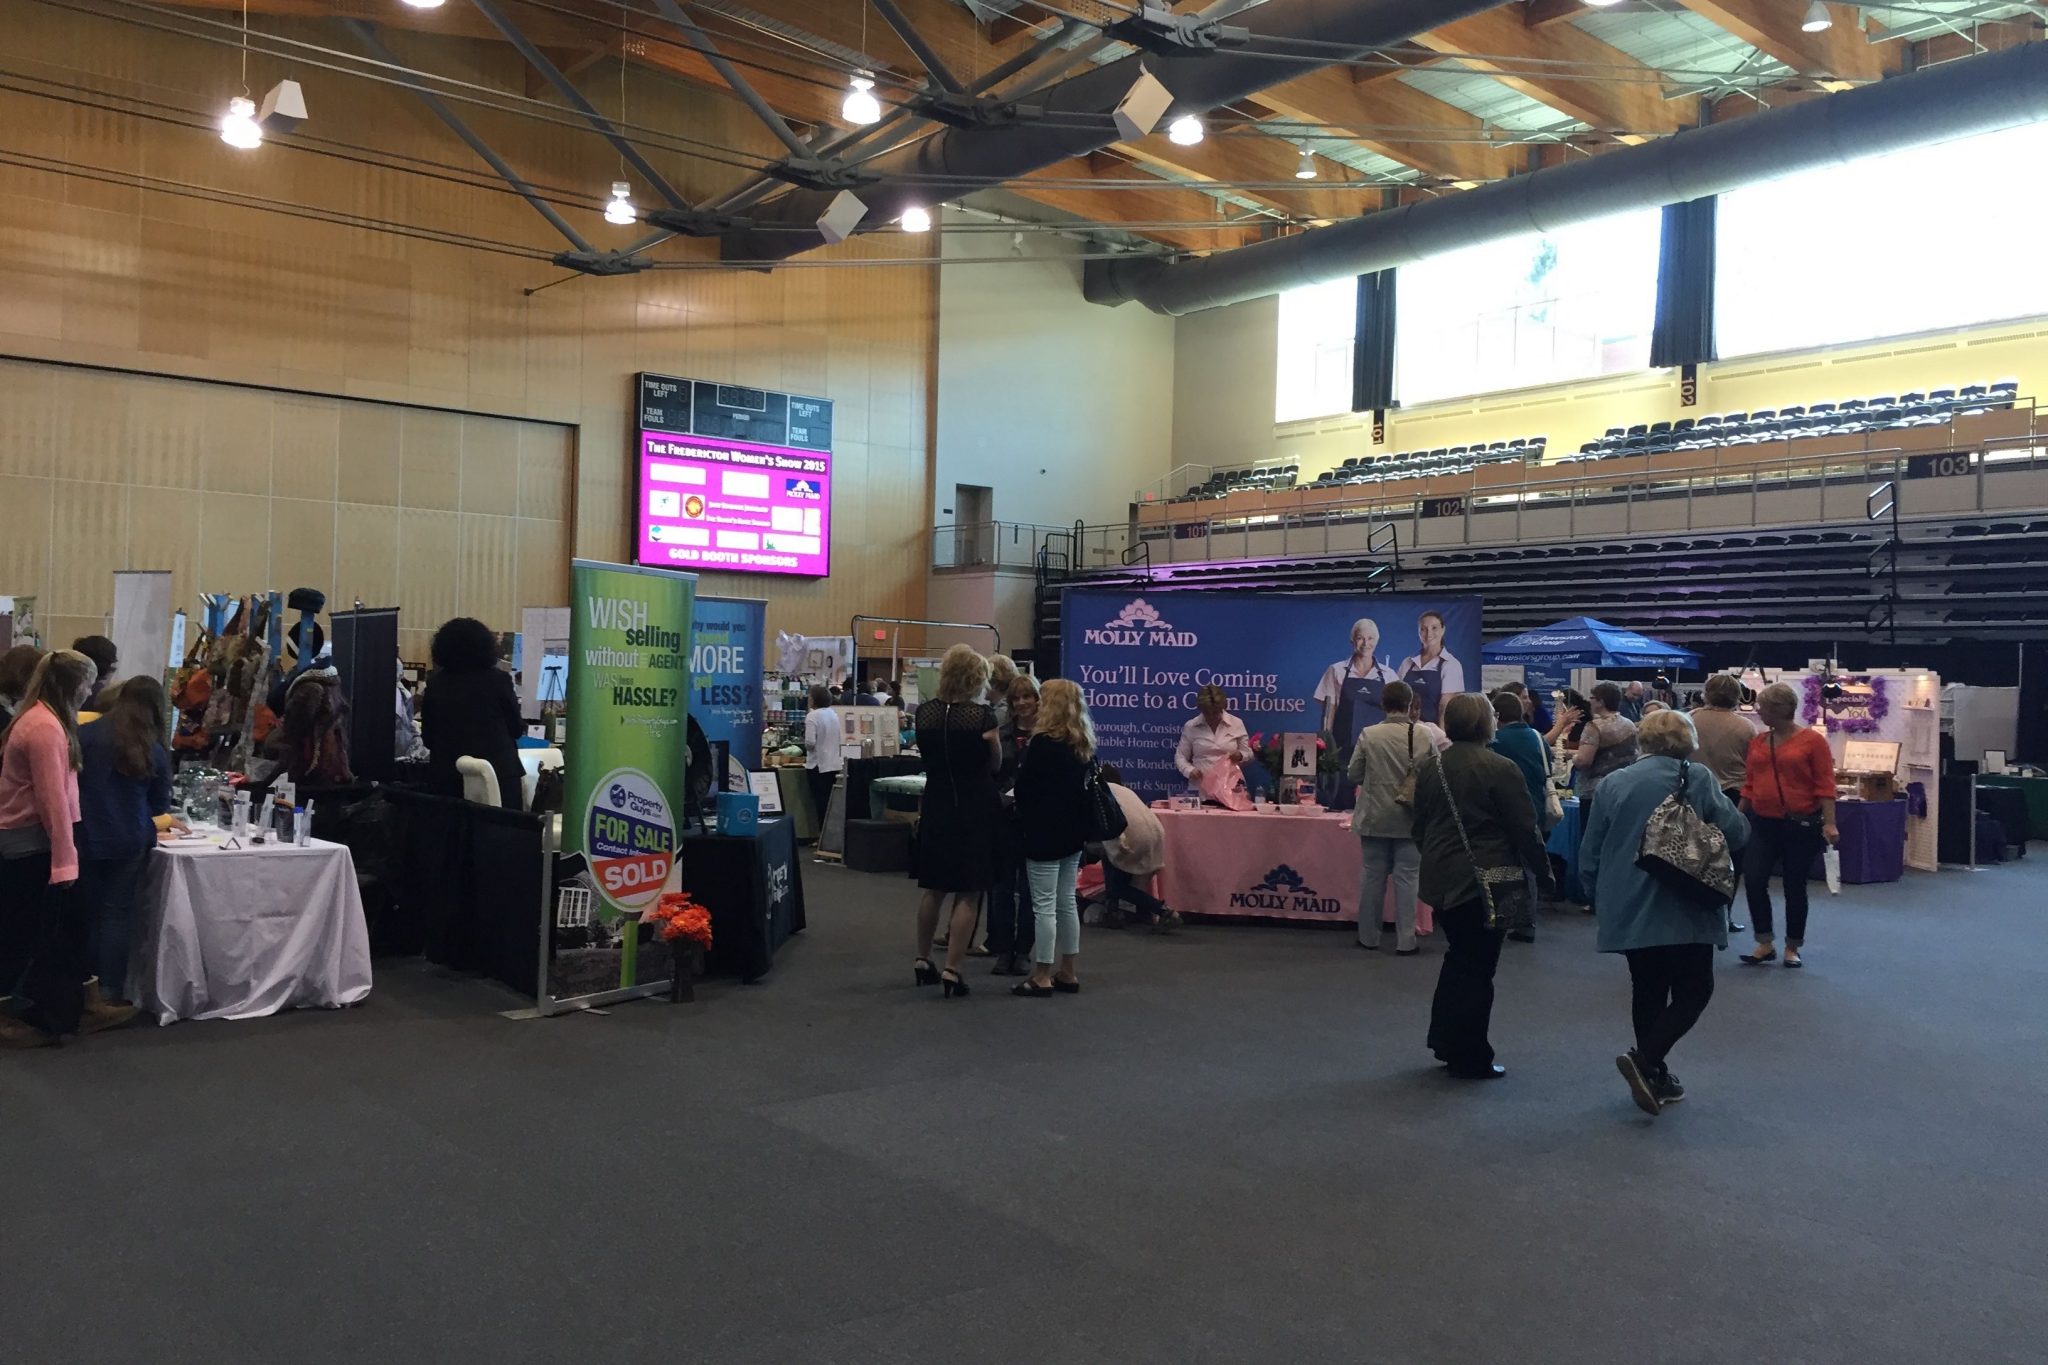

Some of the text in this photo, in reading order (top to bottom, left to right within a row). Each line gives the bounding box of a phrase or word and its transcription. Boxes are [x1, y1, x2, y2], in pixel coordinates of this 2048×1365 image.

[645, 381, 678, 392] TIME OUTS
[653, 390, 668, 398] LEFT
[1681, 376, 1694, 406] 102
[646, 407, 664, 416] TEAM
[792, 402, 804, 410] TIME
[798, 410, 812, 418] LEFT
[644, 414, 664, 424] FOULS
[790, 434, 808, 442] FOULS
[792, 426, 808, 434] TEAM
[1371, 421, 1383, 445] 101
[804, 460, 826, 472] 2015
[1928, 456, 1968, 476] 103
[1435, 501, 1460, 516] 102
[1187, 526, 1204, 538] 101
[669, 548, 700, 560] GOLD
[702, 551, 739, 564] BOOTH
[589, 596, 648, 632] WISH
[626, 626, 680, 654] selling
[1084, 630, 1198, 647] MOLLY MAID
[586, 646, 638, 668] without
[648, 654, 685, 670] AGENT
[1080, 665, 1278, 693] You'll Love Coming
[613, 686, 677, 706] HASSLE?
[1083, 688, 1138, 708] Home
[1143, 693, 1164, 708] to
[1167, 696, 1178, 710] a
[1246, 693, 1305, 712] House
[1098, 736, 1126, 748] liable
[1127, 738, 1159, 748] Home
[1125, 760, 1134, 768] &
[1143, 782, 1152, 790] &
[628, 791, 663, 812] Property
[594, 813, 669, 852] FOR SALE
[596, 842, 628, 855] Contact
[604, 860, 667, 890] SOLD
[1230, 894, 1340, 912] MOLLY MAID
